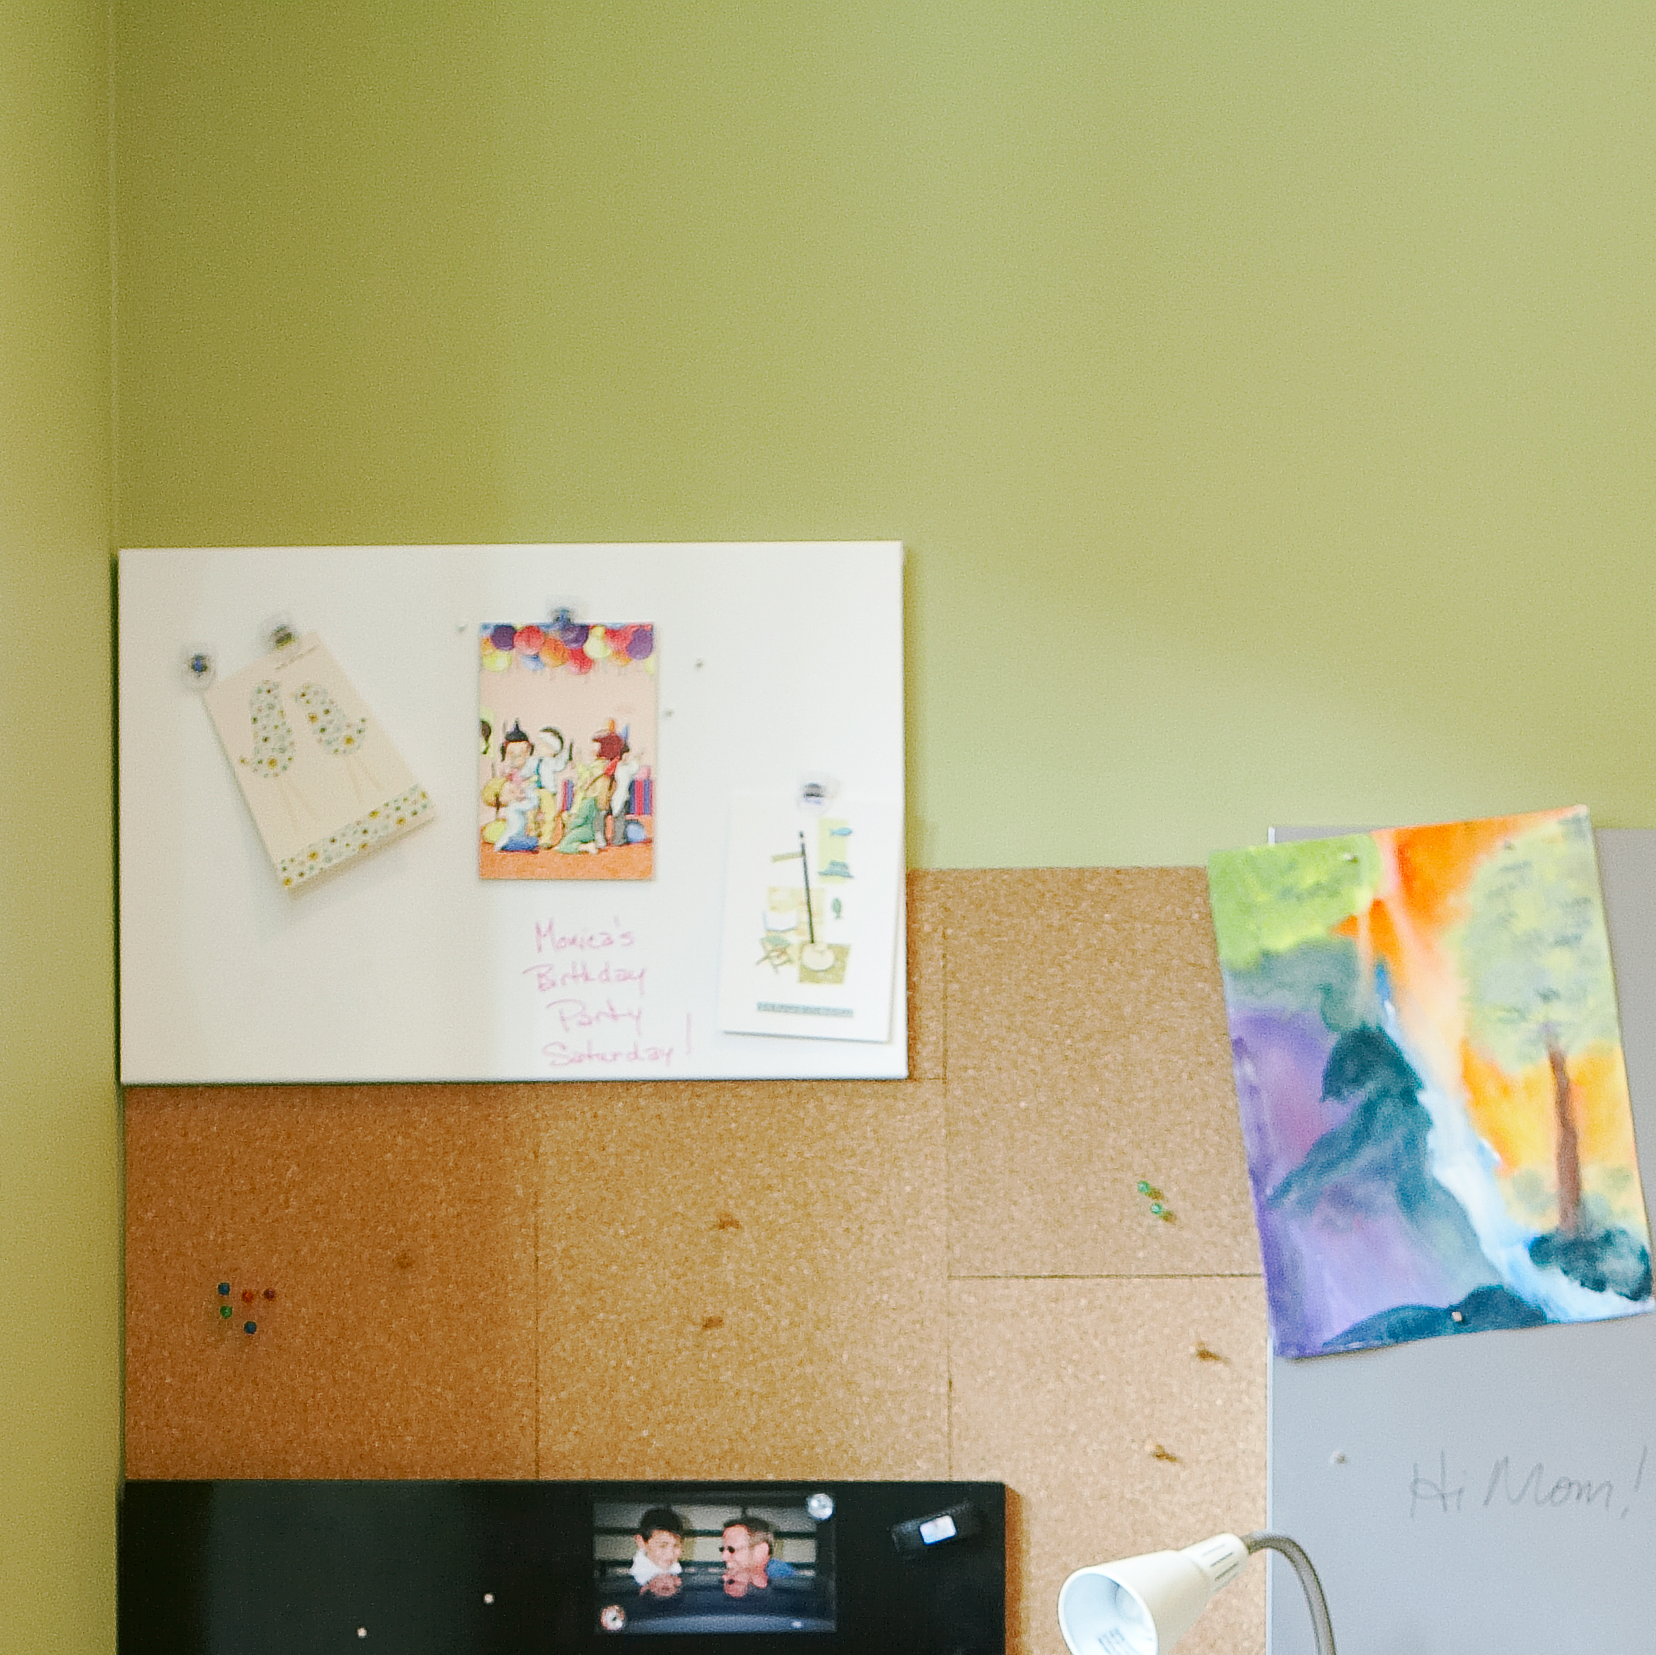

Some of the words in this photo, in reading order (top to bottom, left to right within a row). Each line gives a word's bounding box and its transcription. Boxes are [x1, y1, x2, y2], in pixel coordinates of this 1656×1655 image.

[534, 916, 635, 954] Monica's
[523, 961, 647, 997] Birthday
[546, 997, 644, 1037] Party
[1409, 1450, 1465, 1520] Hi
